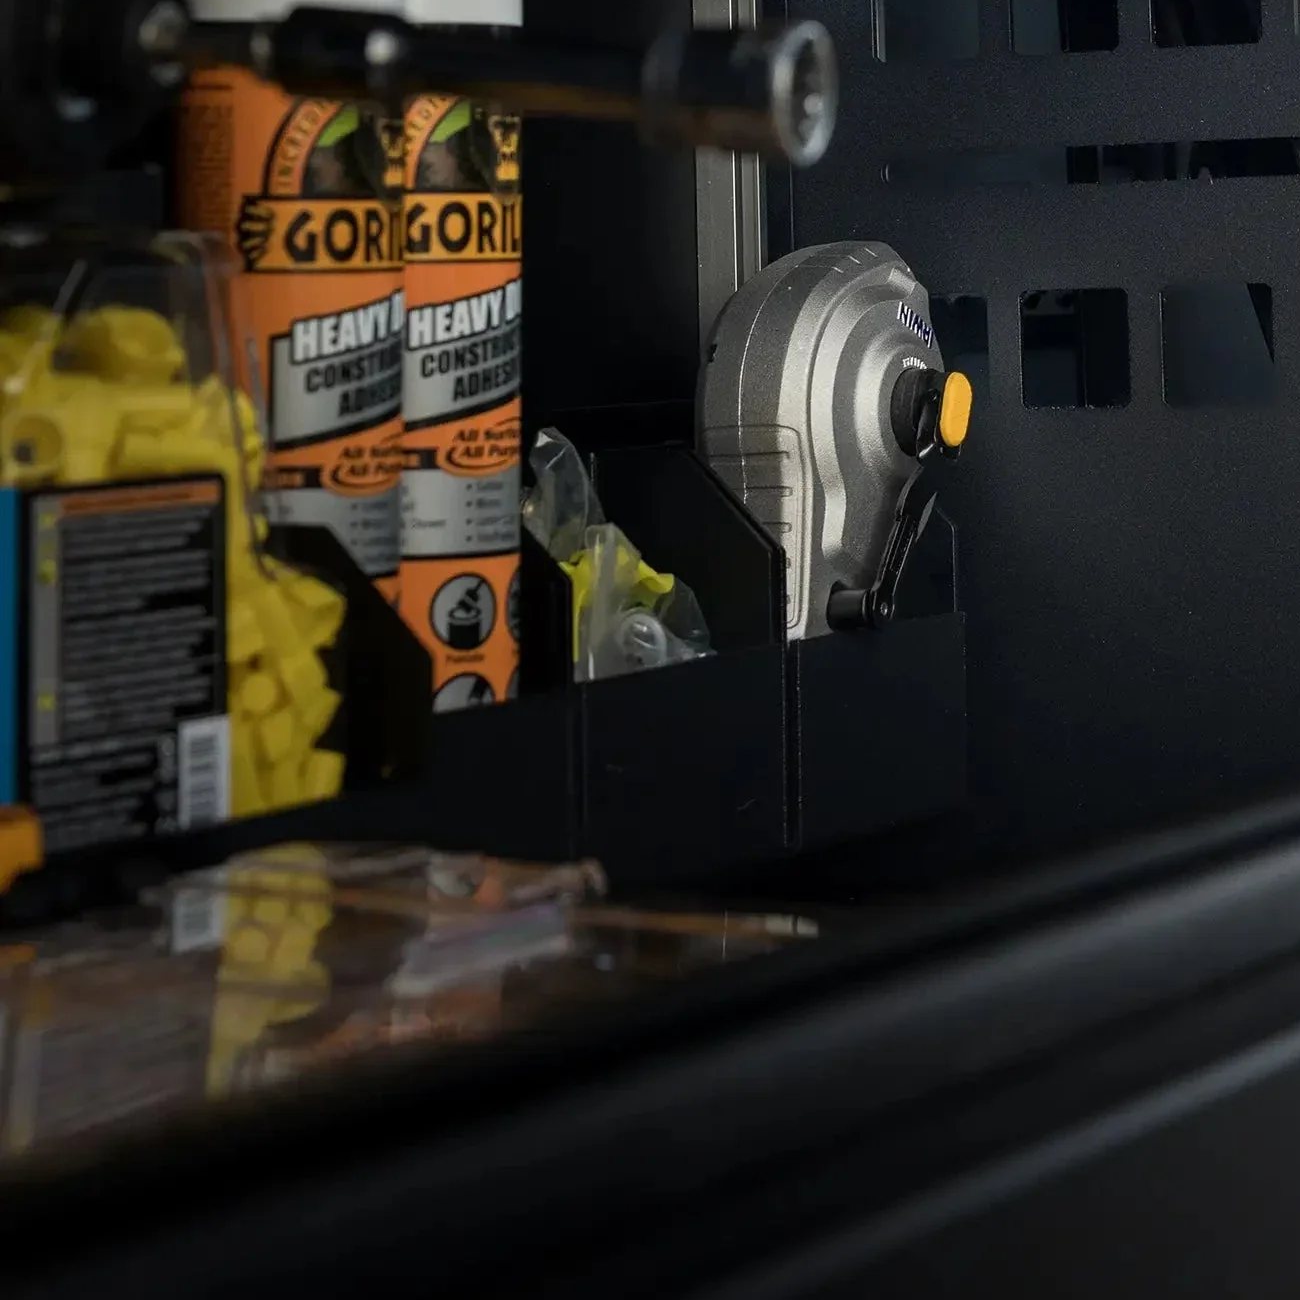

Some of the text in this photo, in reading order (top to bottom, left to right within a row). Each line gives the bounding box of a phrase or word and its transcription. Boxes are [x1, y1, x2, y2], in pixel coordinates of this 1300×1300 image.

[284, 208, 398, 263] GORI
[405, 201, 519, 254] GORIL
[292, 300, 392, 361] HEAVY
[408, 288, 504, 350] HEAVY
